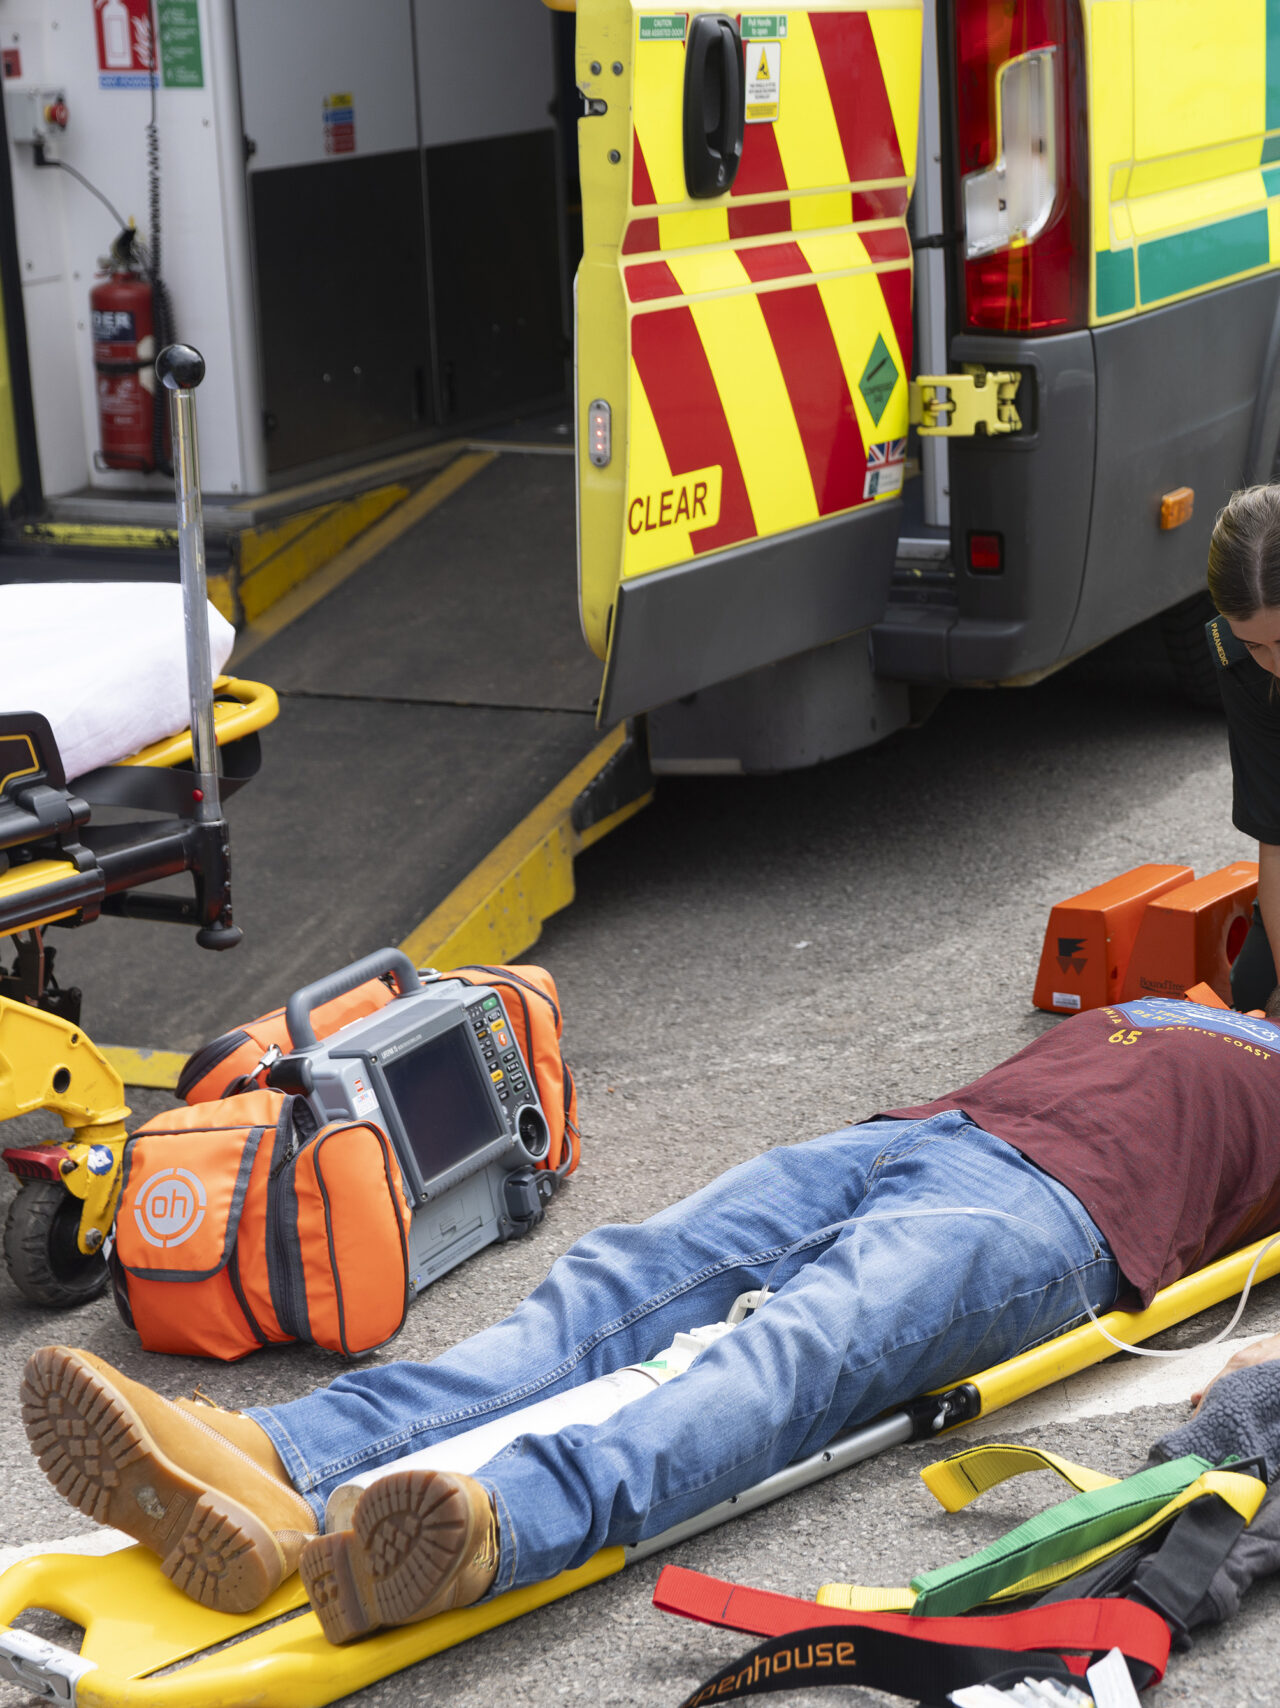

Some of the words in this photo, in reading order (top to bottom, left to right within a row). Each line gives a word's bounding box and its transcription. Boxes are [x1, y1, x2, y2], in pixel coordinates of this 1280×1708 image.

[653, 18, 673, 27] CAUTION
[628, 481, 707, 535] CLEAR
[1211, 622, 1229, 666] PARAMEDIC
[1108, 1029, 1143, 1045] 65
[1155, 1026, 1216, 1038] PACIFIC
[1223, 1036, 1272, 1061] COAST
[151, 1188, 188, 1219] oh
